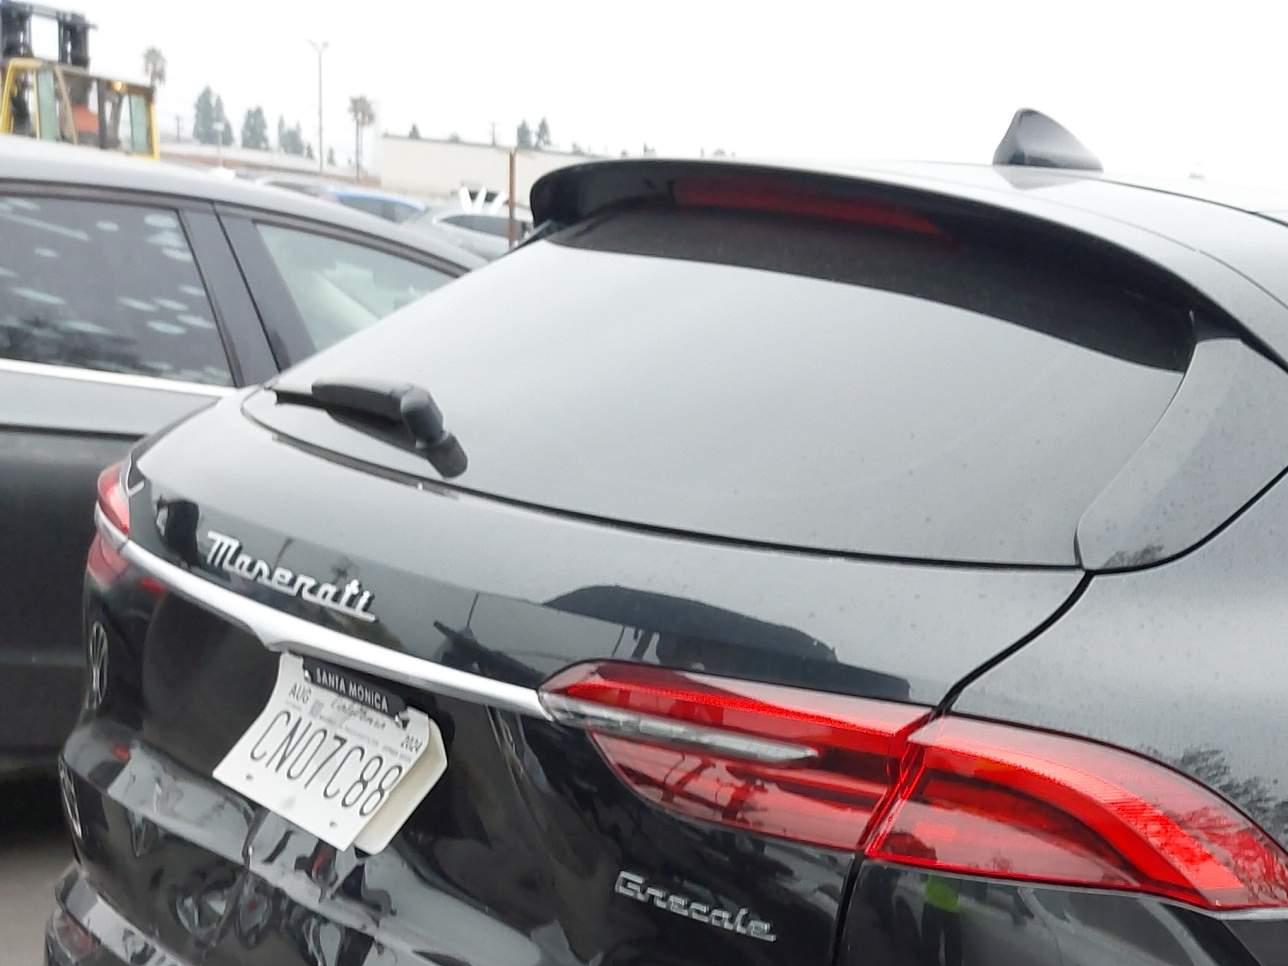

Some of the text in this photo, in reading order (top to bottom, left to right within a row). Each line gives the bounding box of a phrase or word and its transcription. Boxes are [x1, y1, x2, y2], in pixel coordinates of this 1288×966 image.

[207, 530, 380, 624] Maserati
[315, 667, 389, 713] SANTA MONICA
[249, 709, 404, 817] CN07C88
[614, 870, 777, 943] Grecale
